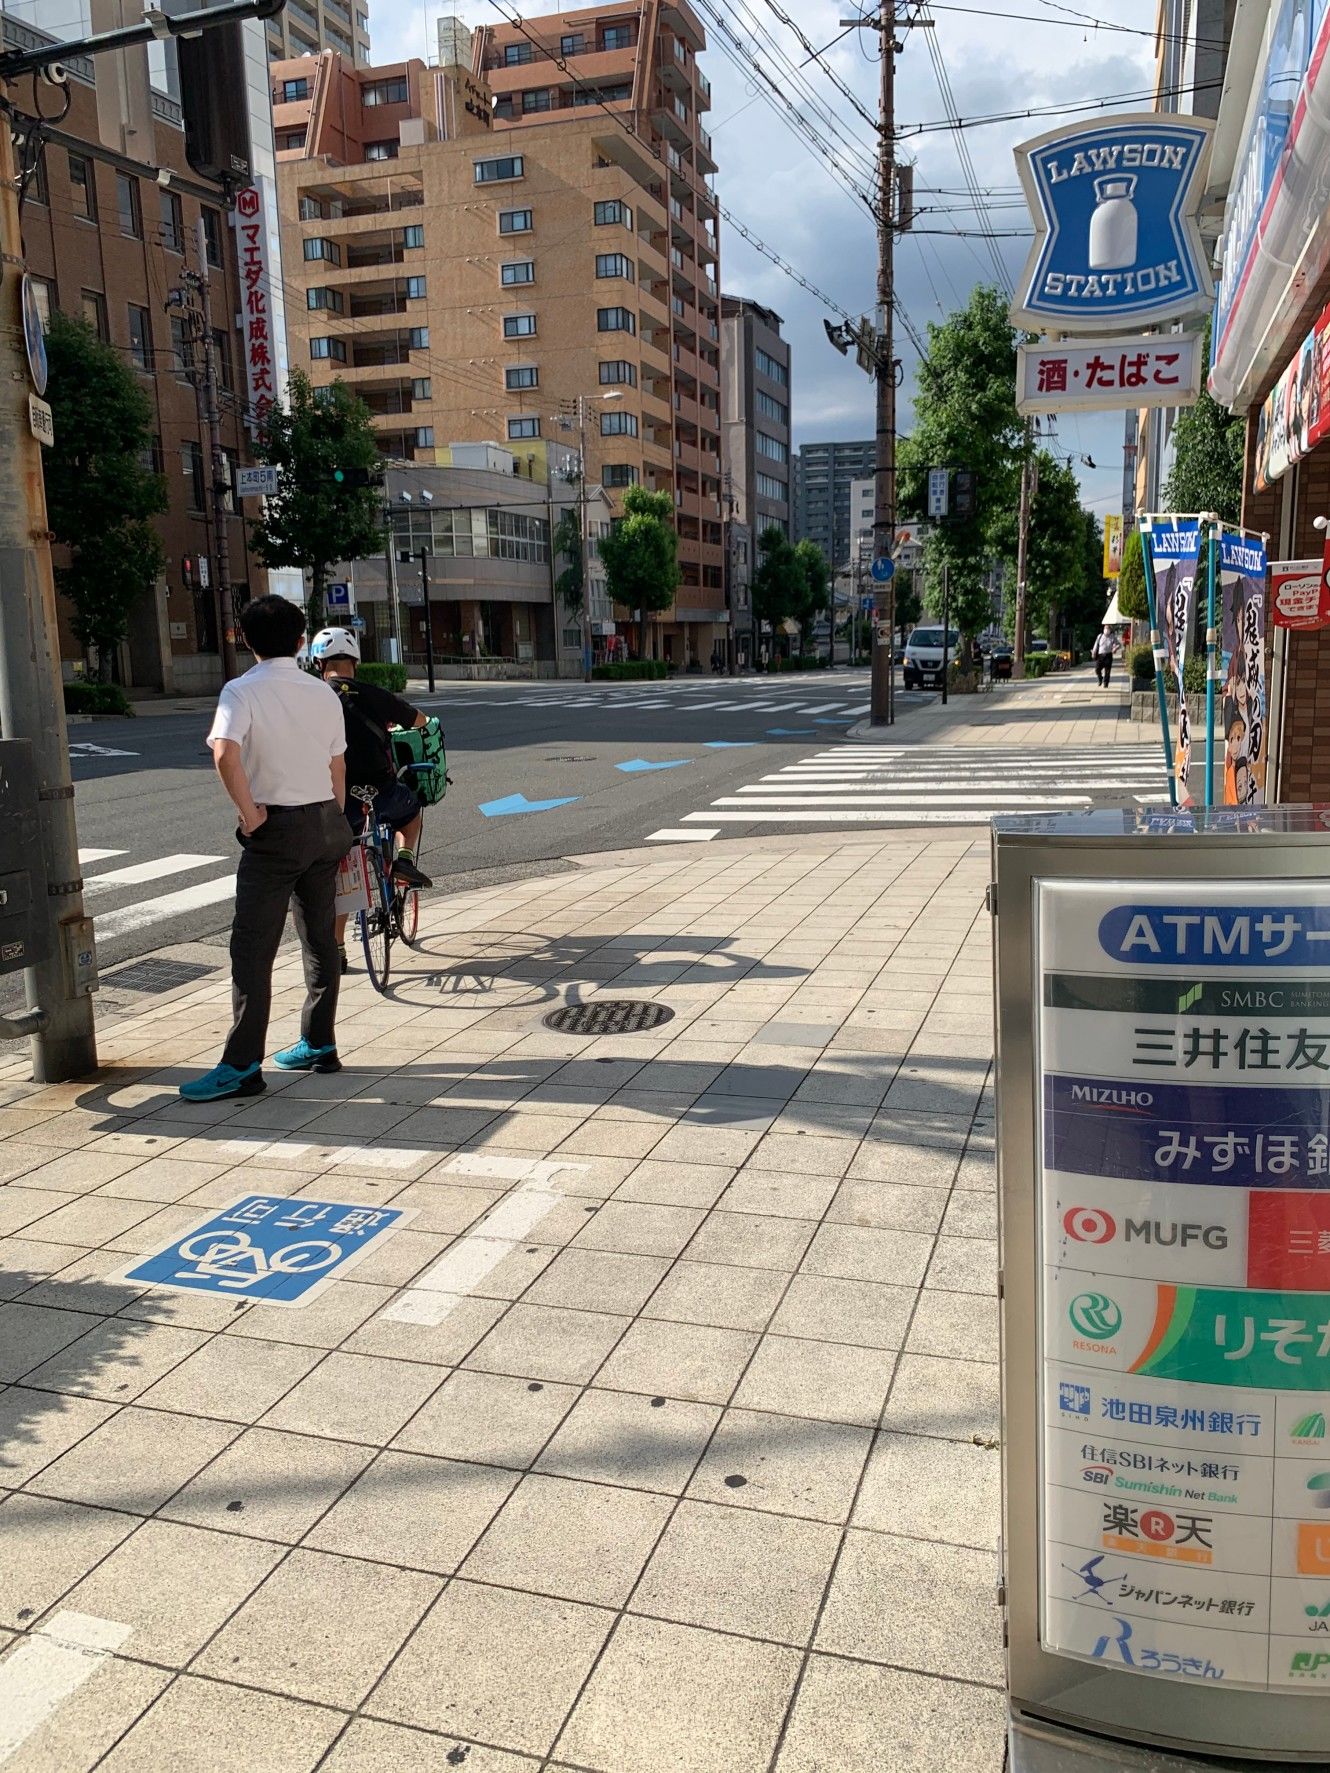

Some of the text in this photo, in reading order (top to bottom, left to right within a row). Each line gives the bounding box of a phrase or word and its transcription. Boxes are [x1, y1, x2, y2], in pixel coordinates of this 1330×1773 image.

[1047, 143, 1186, 184] LAWSON
[1044, 260, 1182, 298] STATION
[1036, 352, 1181, 394] 酒・たばこ
[1152, 530, 1198, 553] LAWSON
[1221, 543, 1263, 571] LAWSON
[1220, 990, 1284, 1008] SMBC
[1132, 1027, 1330, 1071] 三井住友
[1071, 1085, 1153, 1106] MIZUHO
[1125, 1218, 1228, 1250] MUFG
[1072, 1340, 1117, 1355] RESONA
[1101, 1397, 1261, 1437] 池田泉州銀行
[1081, 1444, 1240, 1481] 住信SBIネット銀行
[1082, 1470, 1238, 1504] SBI Sumishin Net Bank
[1118, 1583, 1255, 1617] ジャパンネット銀行
[1140, 1648, 1225, 1680] ろうきん
